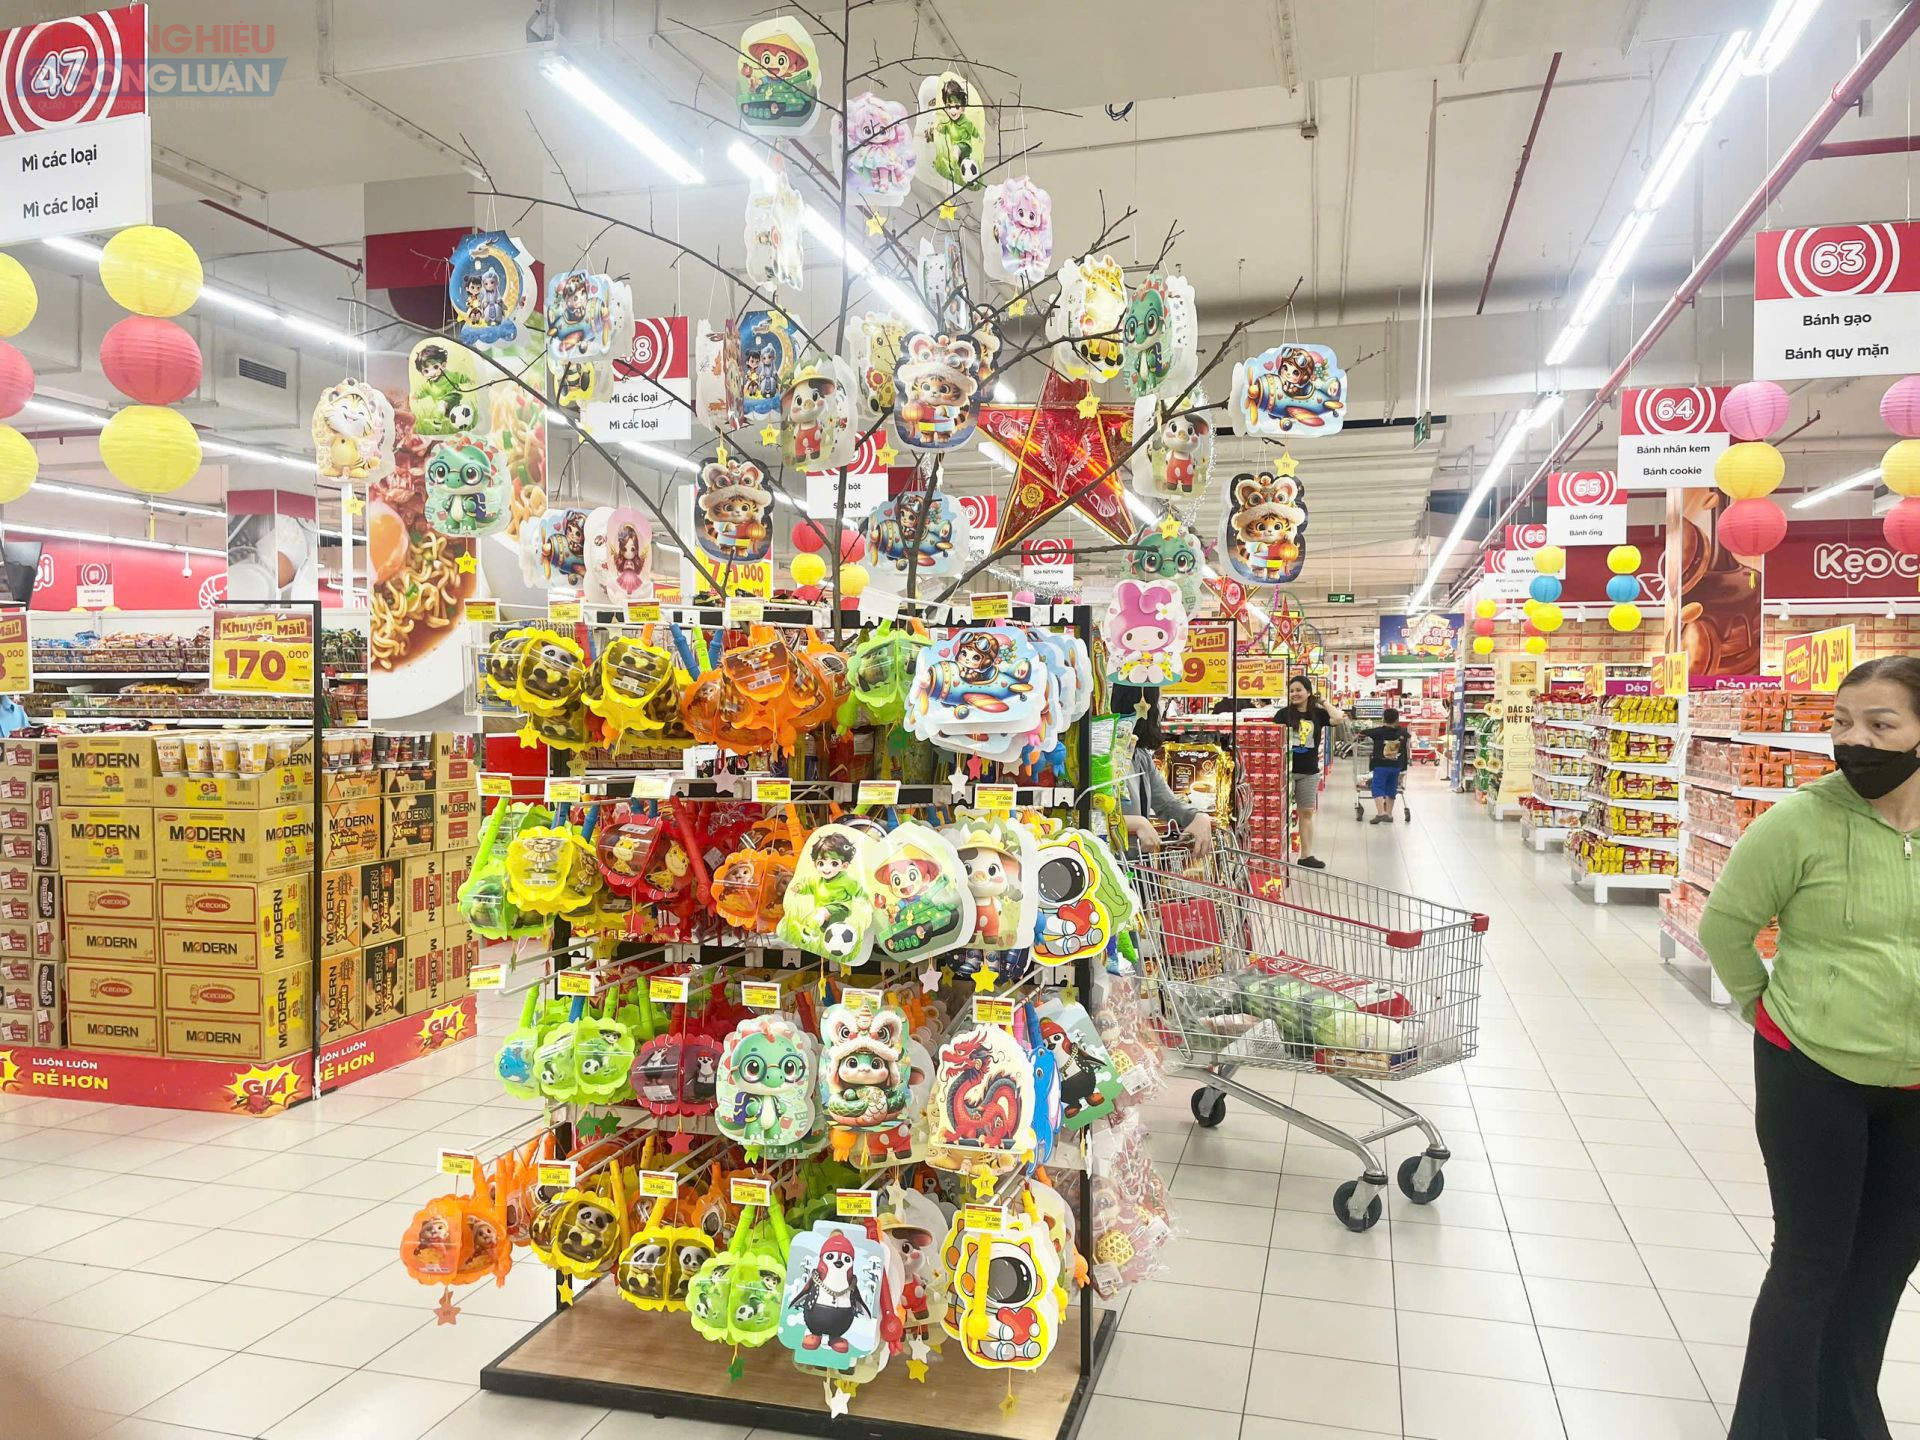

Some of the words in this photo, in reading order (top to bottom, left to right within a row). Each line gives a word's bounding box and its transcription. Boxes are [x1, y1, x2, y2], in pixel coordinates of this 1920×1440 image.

[31, 46, 89, 99] 47
[22, 154, 38, 172] Mì
[42, 151, 67, 169] các
[71, 144, 97, 165] loại
[23, 202, 39, 219] Mì
[43, 198, 68, 215] các
[72, 192, 98, 213] loại
[1810, 240, 1867, 277] 63
[1803, 313, 1839, 326] Bánh
[1844, 314, 1872, 326] gạo
[1785, 347, 1821, 360] Bánh
[1826, 347, 1853, 359] quy
[1857, 344, 1889, 358] mặn
[623, 392, 639, 403] các
[641, 392, 658, 403] loại
[1656, 397, 1695, 421] 64
[609, 420, 620, 430] Mì
[623, 419, 639, 429] các
[641, 418, 658, 429] loại
[1637, 445, 1660, 454] Bánh
[1663, 445, 1687, 453] nhân
[1689, 444, 1710, 453] kem
[1643, 467, 1667, 475] Bánh
[1670, 466, 1702, 475] cookie
[1574, 479, 1601, 497] 65
[1525, 530, 1546, 543] 66
[1816, 545, 1892, 584] Kẹo
[224, 649, 286, 681] 170
[287, 650, 309, 659] .000
[1812, 639, 1829, 685] 20
[1238, 675, 1265, 691] 64
[1625, 683, 1648, 693] Dẻo
[72, 752, 140, 769] MODERN
[392, 807, 431, 822] MODERN
[441, 801, 476, 815] MODERN
[72, 824, 140, 840] MODERN
[266, 822, 314, 841] MODERN
[329, 814, 374, 831] MODERN
[169, 826, 245, 843] MODERN
[428, 861, 436, 922] MODERN
[371, 870, 380, 934] MODERN
[326, 879, 336, 946] MODERN
[273, 888, 284, 959] MODERN
[86, 936, 137, 949] MODERN
[182, 941, 238, 954] MODERN
[430, 938, 438, 999] MODERN
[374, 951, 383, 1016] MODERN
[329, 965, 337, 1032] MODERN
[278, 978, 288, 1048] MODERN
[428, 1010, 459, 1035] GIÁ
[87, 1023, 139, 1037] MODERN
[186, 1030, 242, 1043] MODERN
[319, 1051, 339, 1064] UÔN
[341, 1040, 367, 1056] LUÔN
[32, 1057, 63, 1067] LUÔN
[66, 1060, 98, 1070] LUÔN
[338, 1052, 376, 1077] HƠN
[32, 1068, 59, 1086] RẺ
[62, 1075, 108, 1090] HƠN
[242, 1072, 287, 1097] GIÁ
